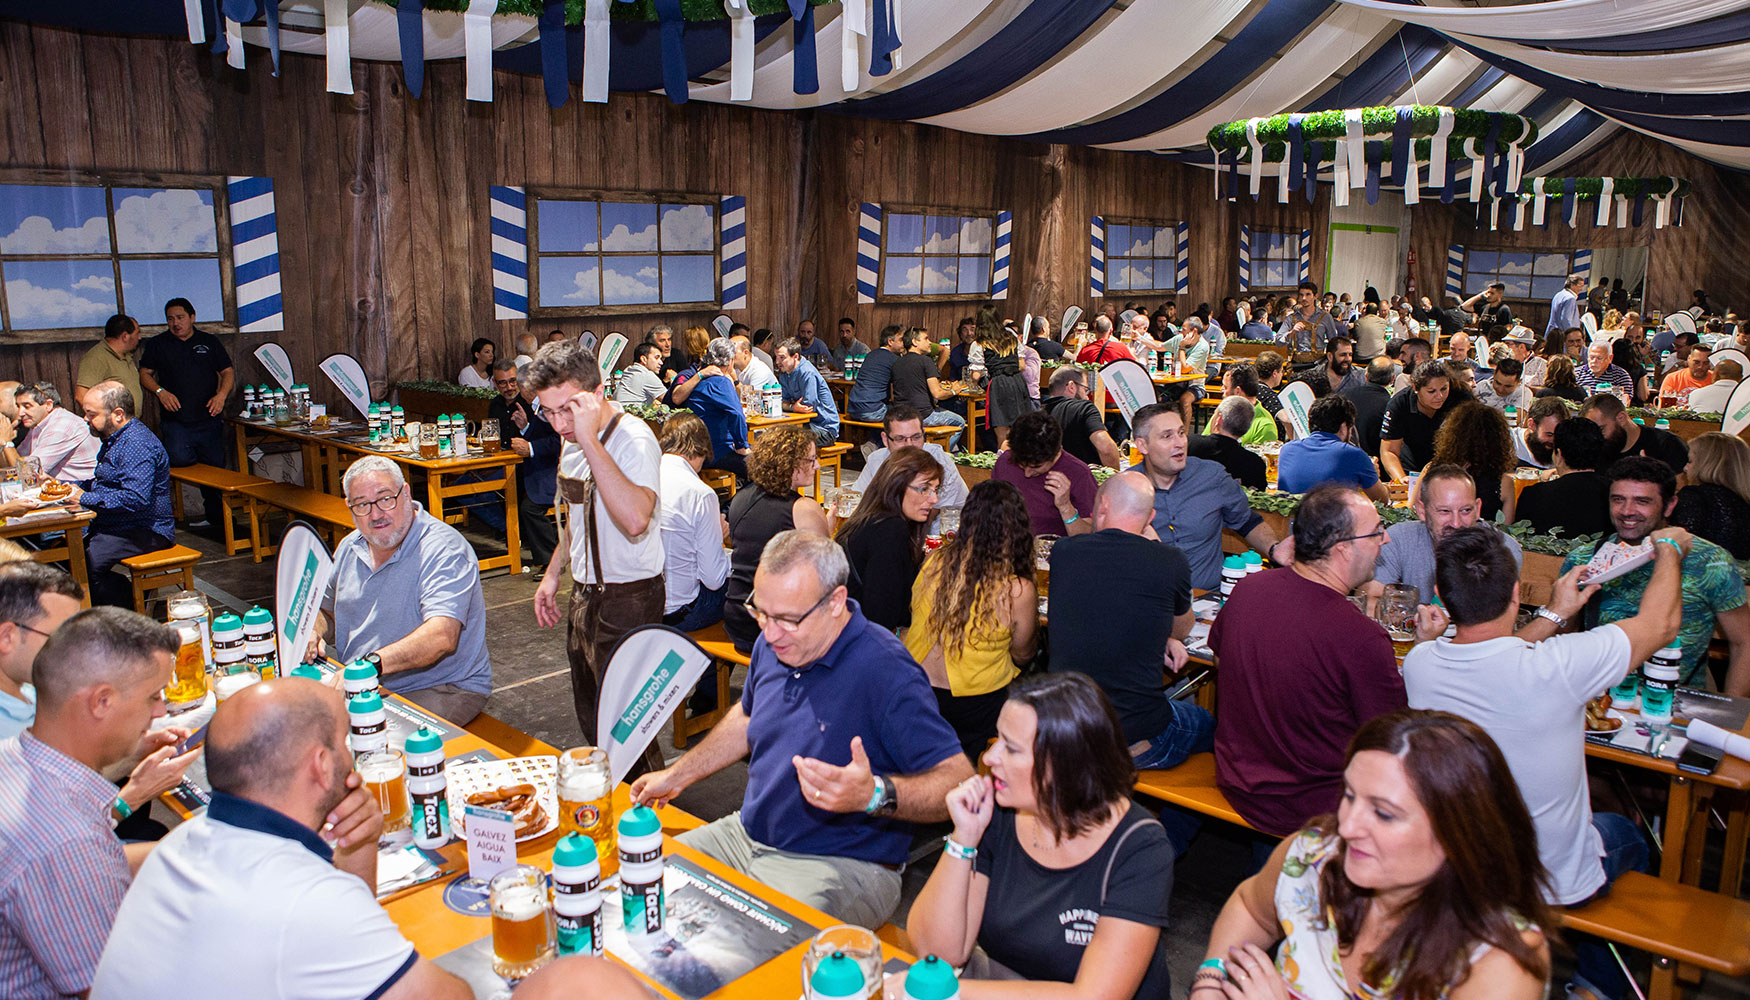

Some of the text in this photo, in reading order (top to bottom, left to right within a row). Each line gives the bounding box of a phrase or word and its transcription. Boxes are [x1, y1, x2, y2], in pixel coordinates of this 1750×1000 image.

[288, 568, 312, 627] hansgrohe
[248, 656, 268, 664] BORA
[621, 668, 670, 727] hansgrohe
[640, 710, 660, 735] showers
[663, 684, 680, 705] mixers
[423, 795, 438, 836] Tacx
[473, 828, 506, 843] GALVEZ
[477, 841, 506, 854] AIGUA
[482, 852, 502, 864] BAIX
[645, 883, 660, 930] Tacx
[1059, 908, 1099, 925] HAPPINE
